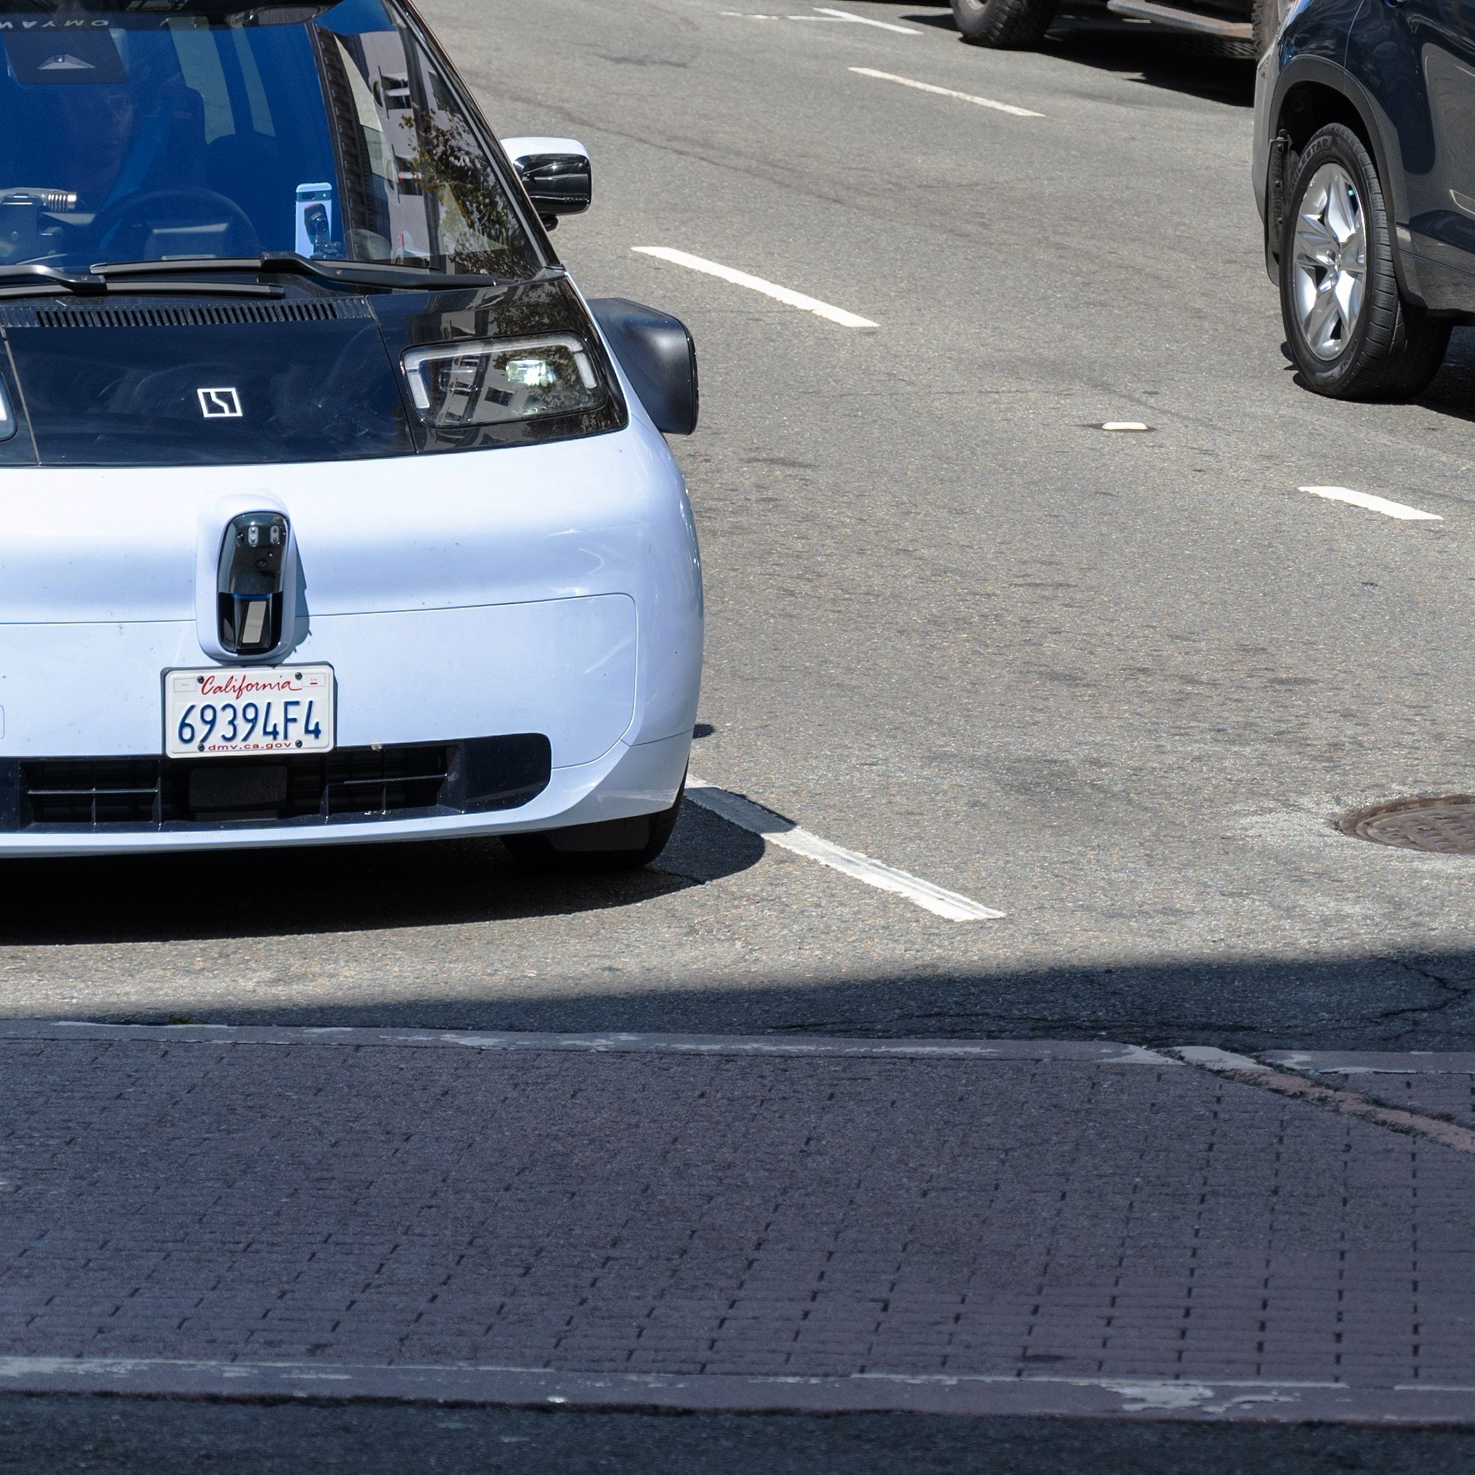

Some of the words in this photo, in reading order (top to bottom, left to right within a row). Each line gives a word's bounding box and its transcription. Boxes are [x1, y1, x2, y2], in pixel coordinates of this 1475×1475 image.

[200, 674, 303, 700] California
[177, 700, 322, 745] 69394F4
[207, 741, 293, 752] dmv.ca.gov
